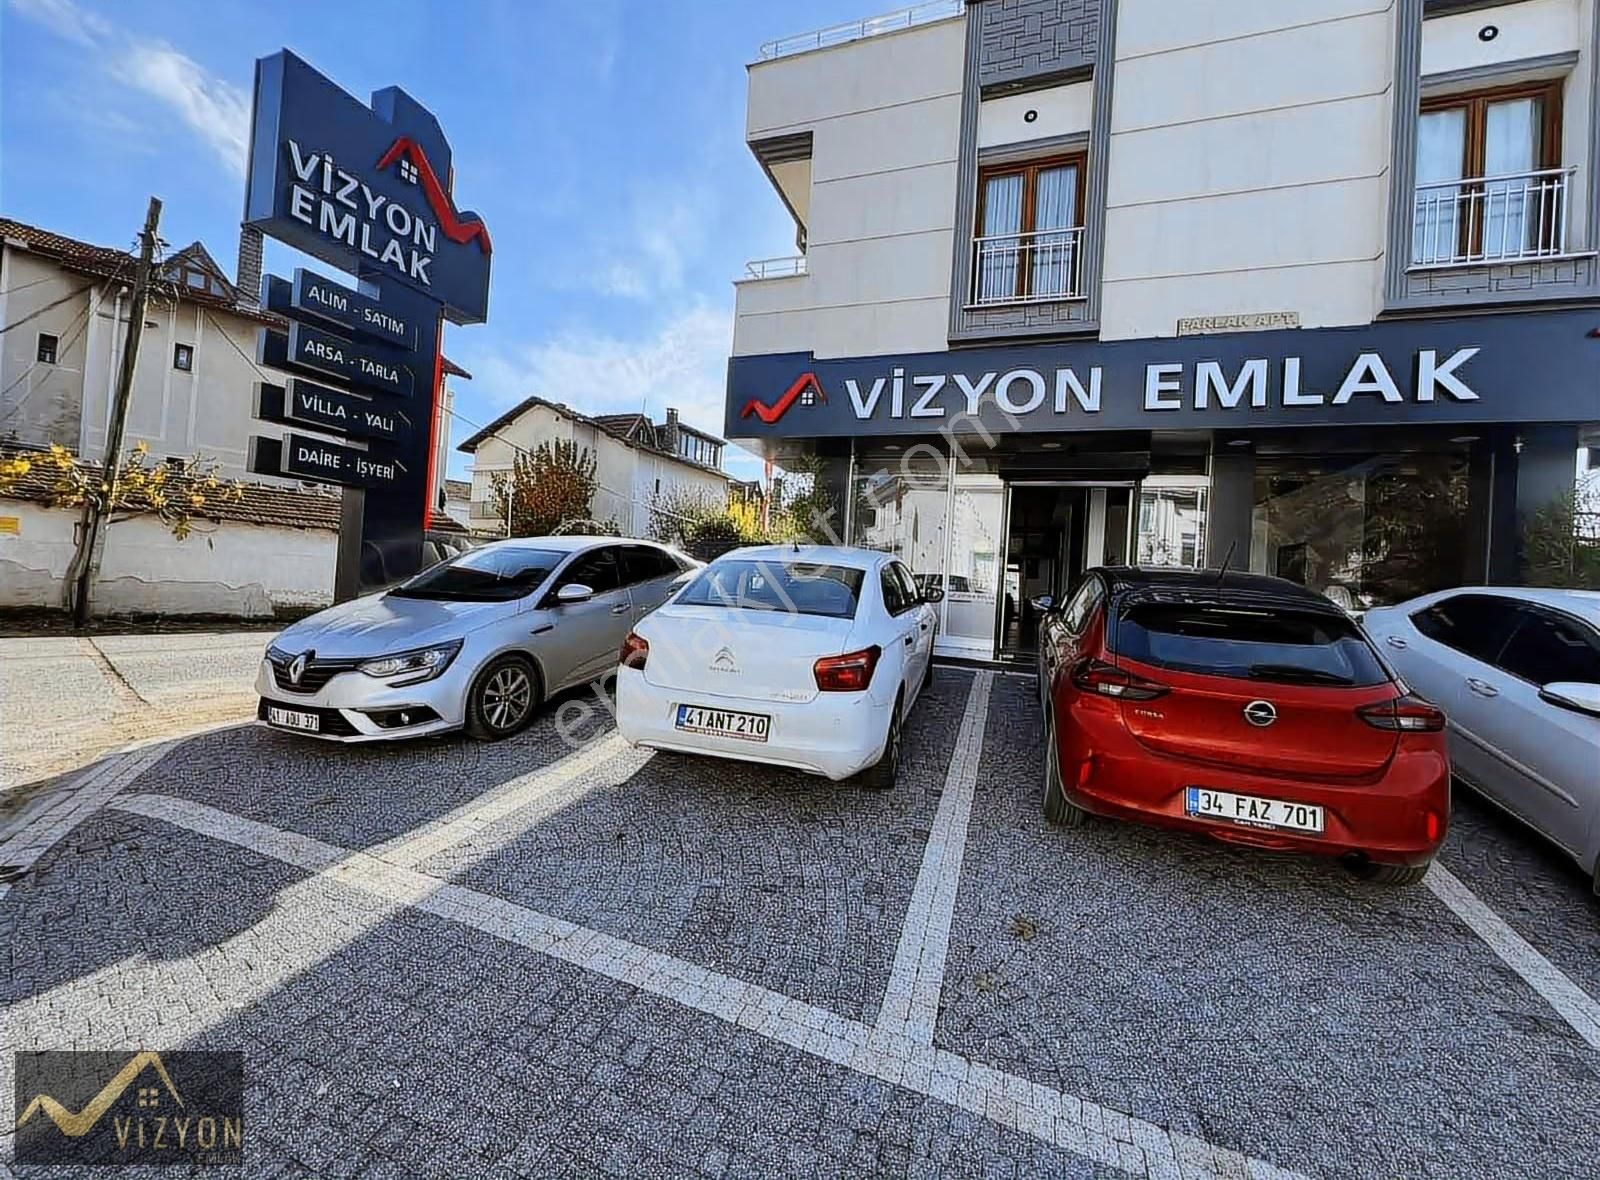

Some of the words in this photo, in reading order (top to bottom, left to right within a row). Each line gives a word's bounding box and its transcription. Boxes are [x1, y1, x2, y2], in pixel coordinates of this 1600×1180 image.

[289, 138, 435, 253] VİZYON
[291, 184, 430, 285] EMLAK
[308, 286, 347, 311] ALIM
[364, 309, 404, 335] SATIM
[304, 340, 344, 364] ARSA
[360, 359, 398, 383] TARLA
[845, 368, 1102, 419] VİZYON
[1144, 347, 1481, 409] EMLAK
[301, 394, 346, 418] VİLLA
[365, 412, 394, 431] YALI
[298, 448, 340, 468] DAİRE
[686, 710, 704, 726] 41
[706, 712, 735, 730] ANT
[737, 716, 766, 735] 210
[1201, 792, 1223, 813] 34
[1235, 797, 1272, 821] FAZ
[1283, 804, 1317, 829] 701
